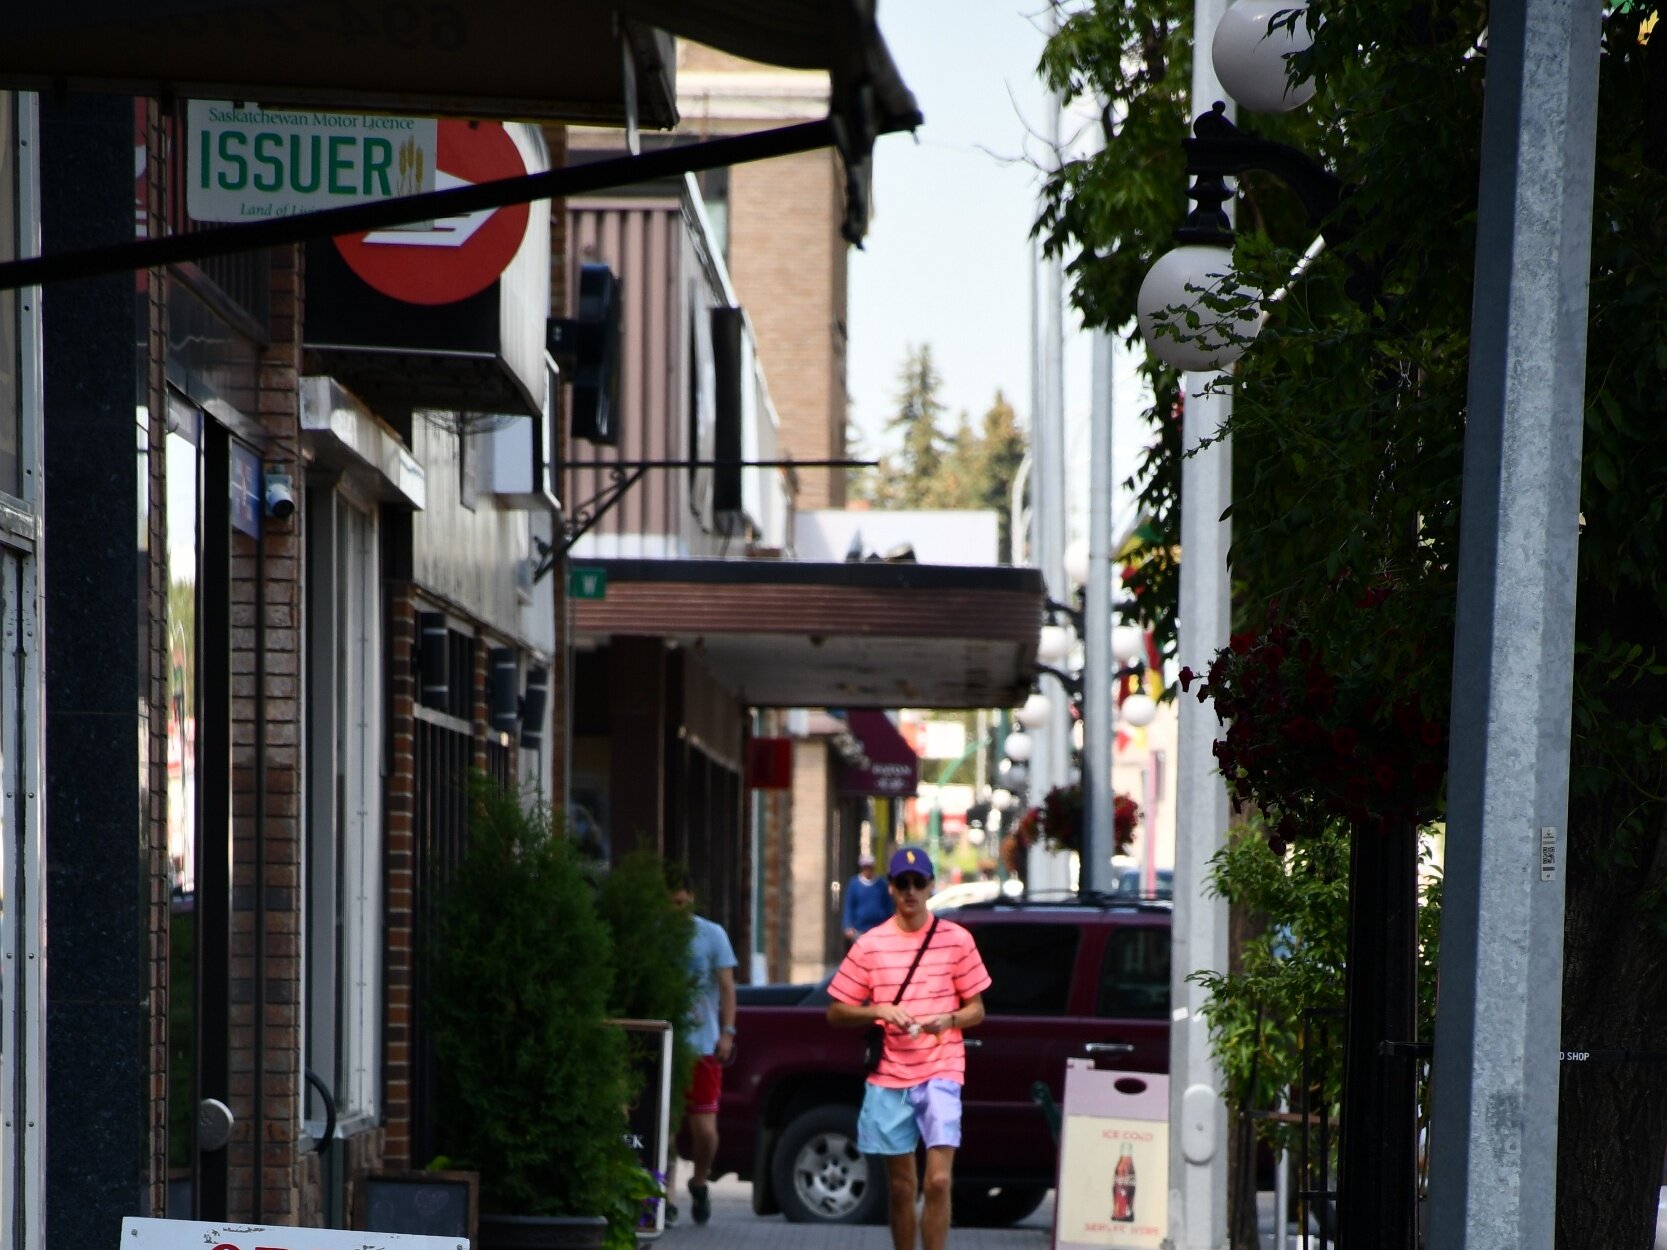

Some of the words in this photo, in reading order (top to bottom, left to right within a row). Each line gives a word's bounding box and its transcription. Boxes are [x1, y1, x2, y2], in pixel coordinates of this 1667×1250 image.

[208, 107, 308, 126] Saskatchewan
[312, 112, 359, 129] Motor
[362, 114, 415, 130] Licence
[200, 130, 392, 196] ISSUER
[240, 203, 272, 216] Land
[276, 204, 288, 217] of
[1567, 1051, 1590, 1061] SHOP
